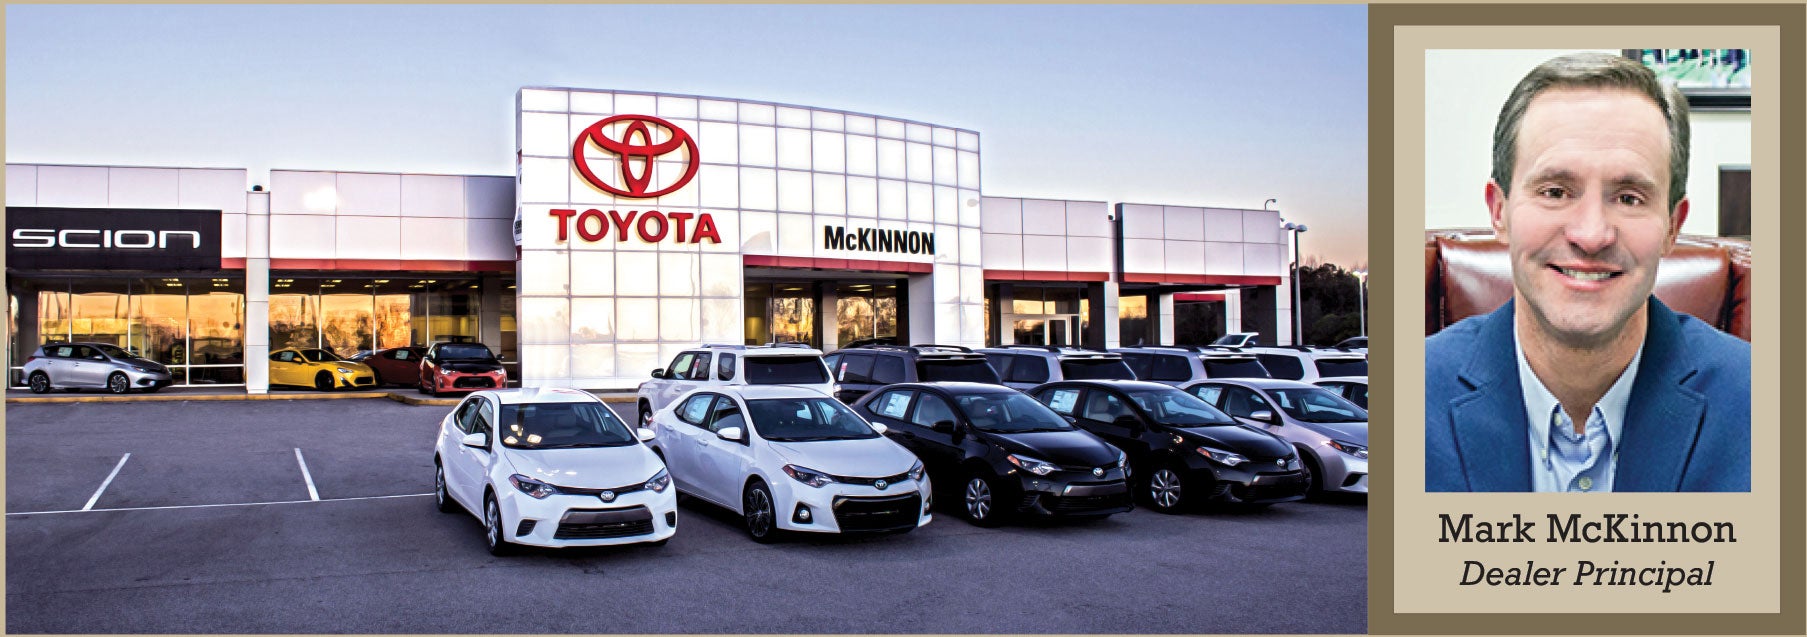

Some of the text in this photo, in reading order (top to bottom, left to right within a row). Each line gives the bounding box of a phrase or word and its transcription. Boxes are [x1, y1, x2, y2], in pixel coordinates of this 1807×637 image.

[12, 228, 201, 249] SCION
[549, 208, 721, 244] TOYOTA
[824, 225, 935, 255] McKINNON
